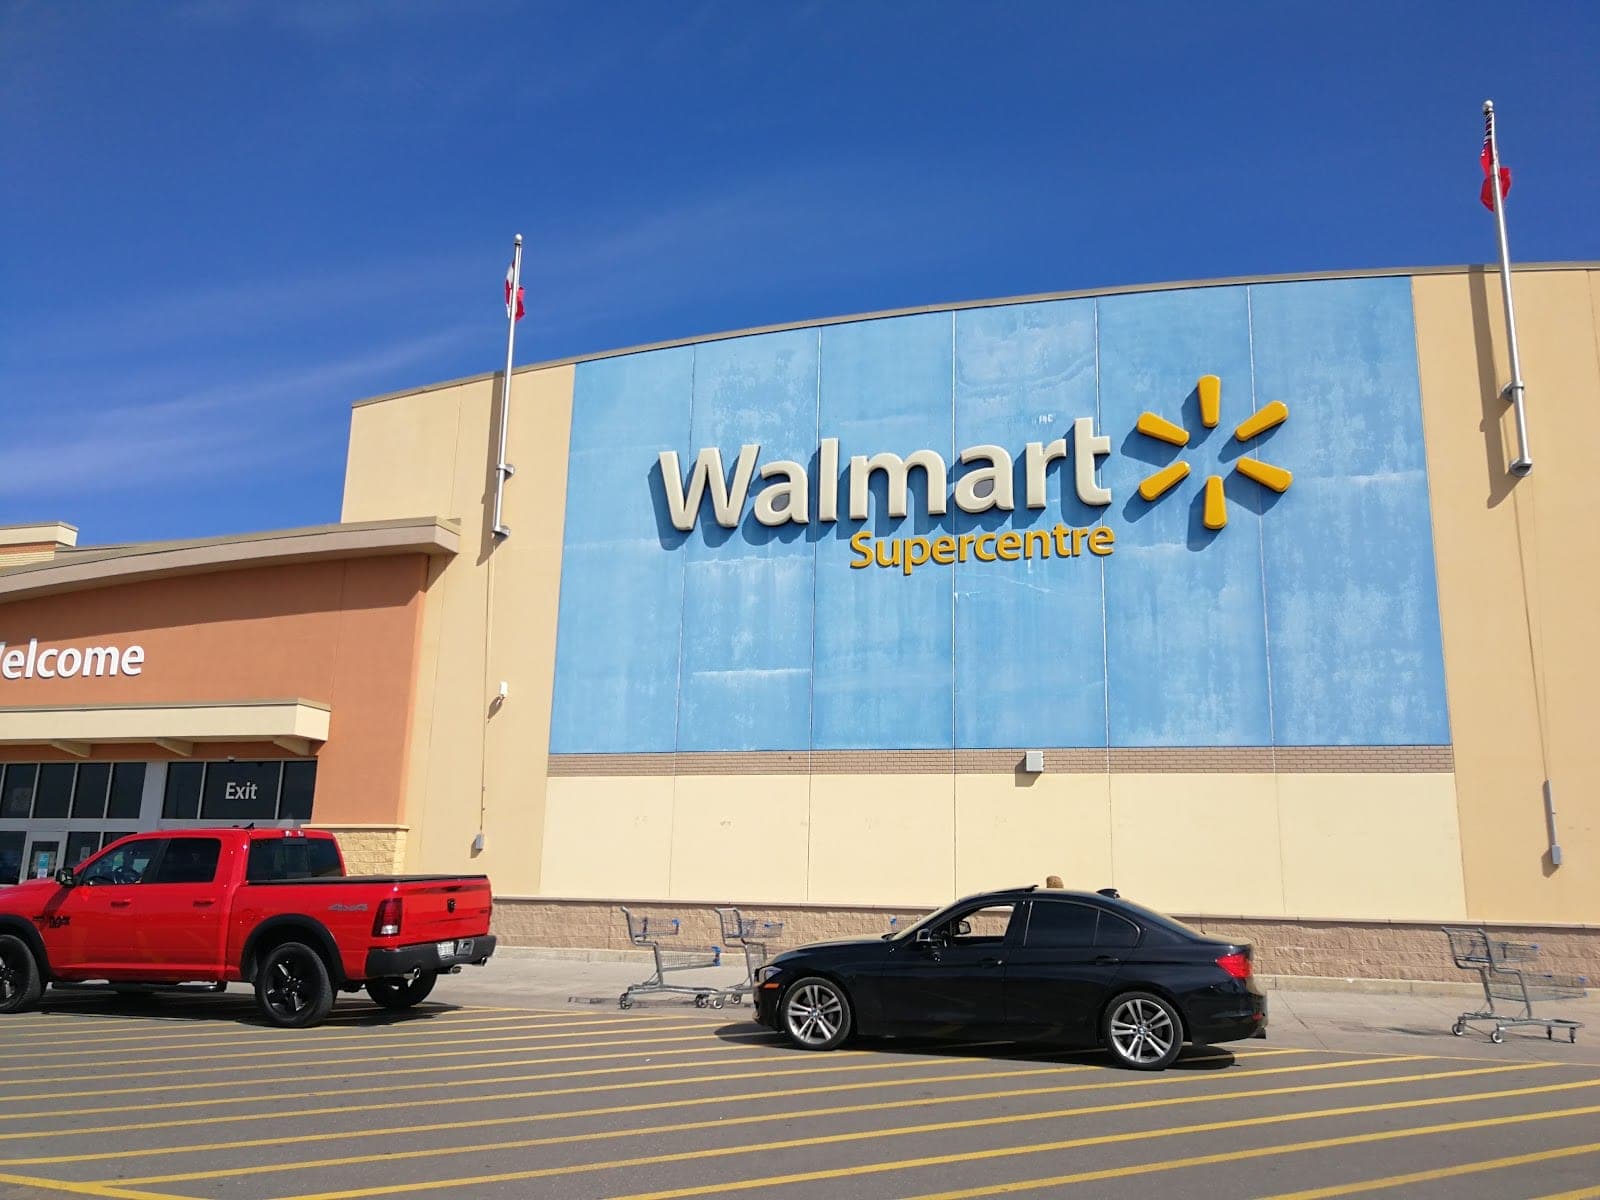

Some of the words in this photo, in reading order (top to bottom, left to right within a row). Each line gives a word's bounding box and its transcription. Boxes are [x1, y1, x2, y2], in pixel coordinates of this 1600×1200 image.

[659, 417, 1112, 531] Walmart
[850, 523, 1115, 575] Supercentre
[0, 638, 145, 679] elcome
[225, 782, 258, 800] Exit
